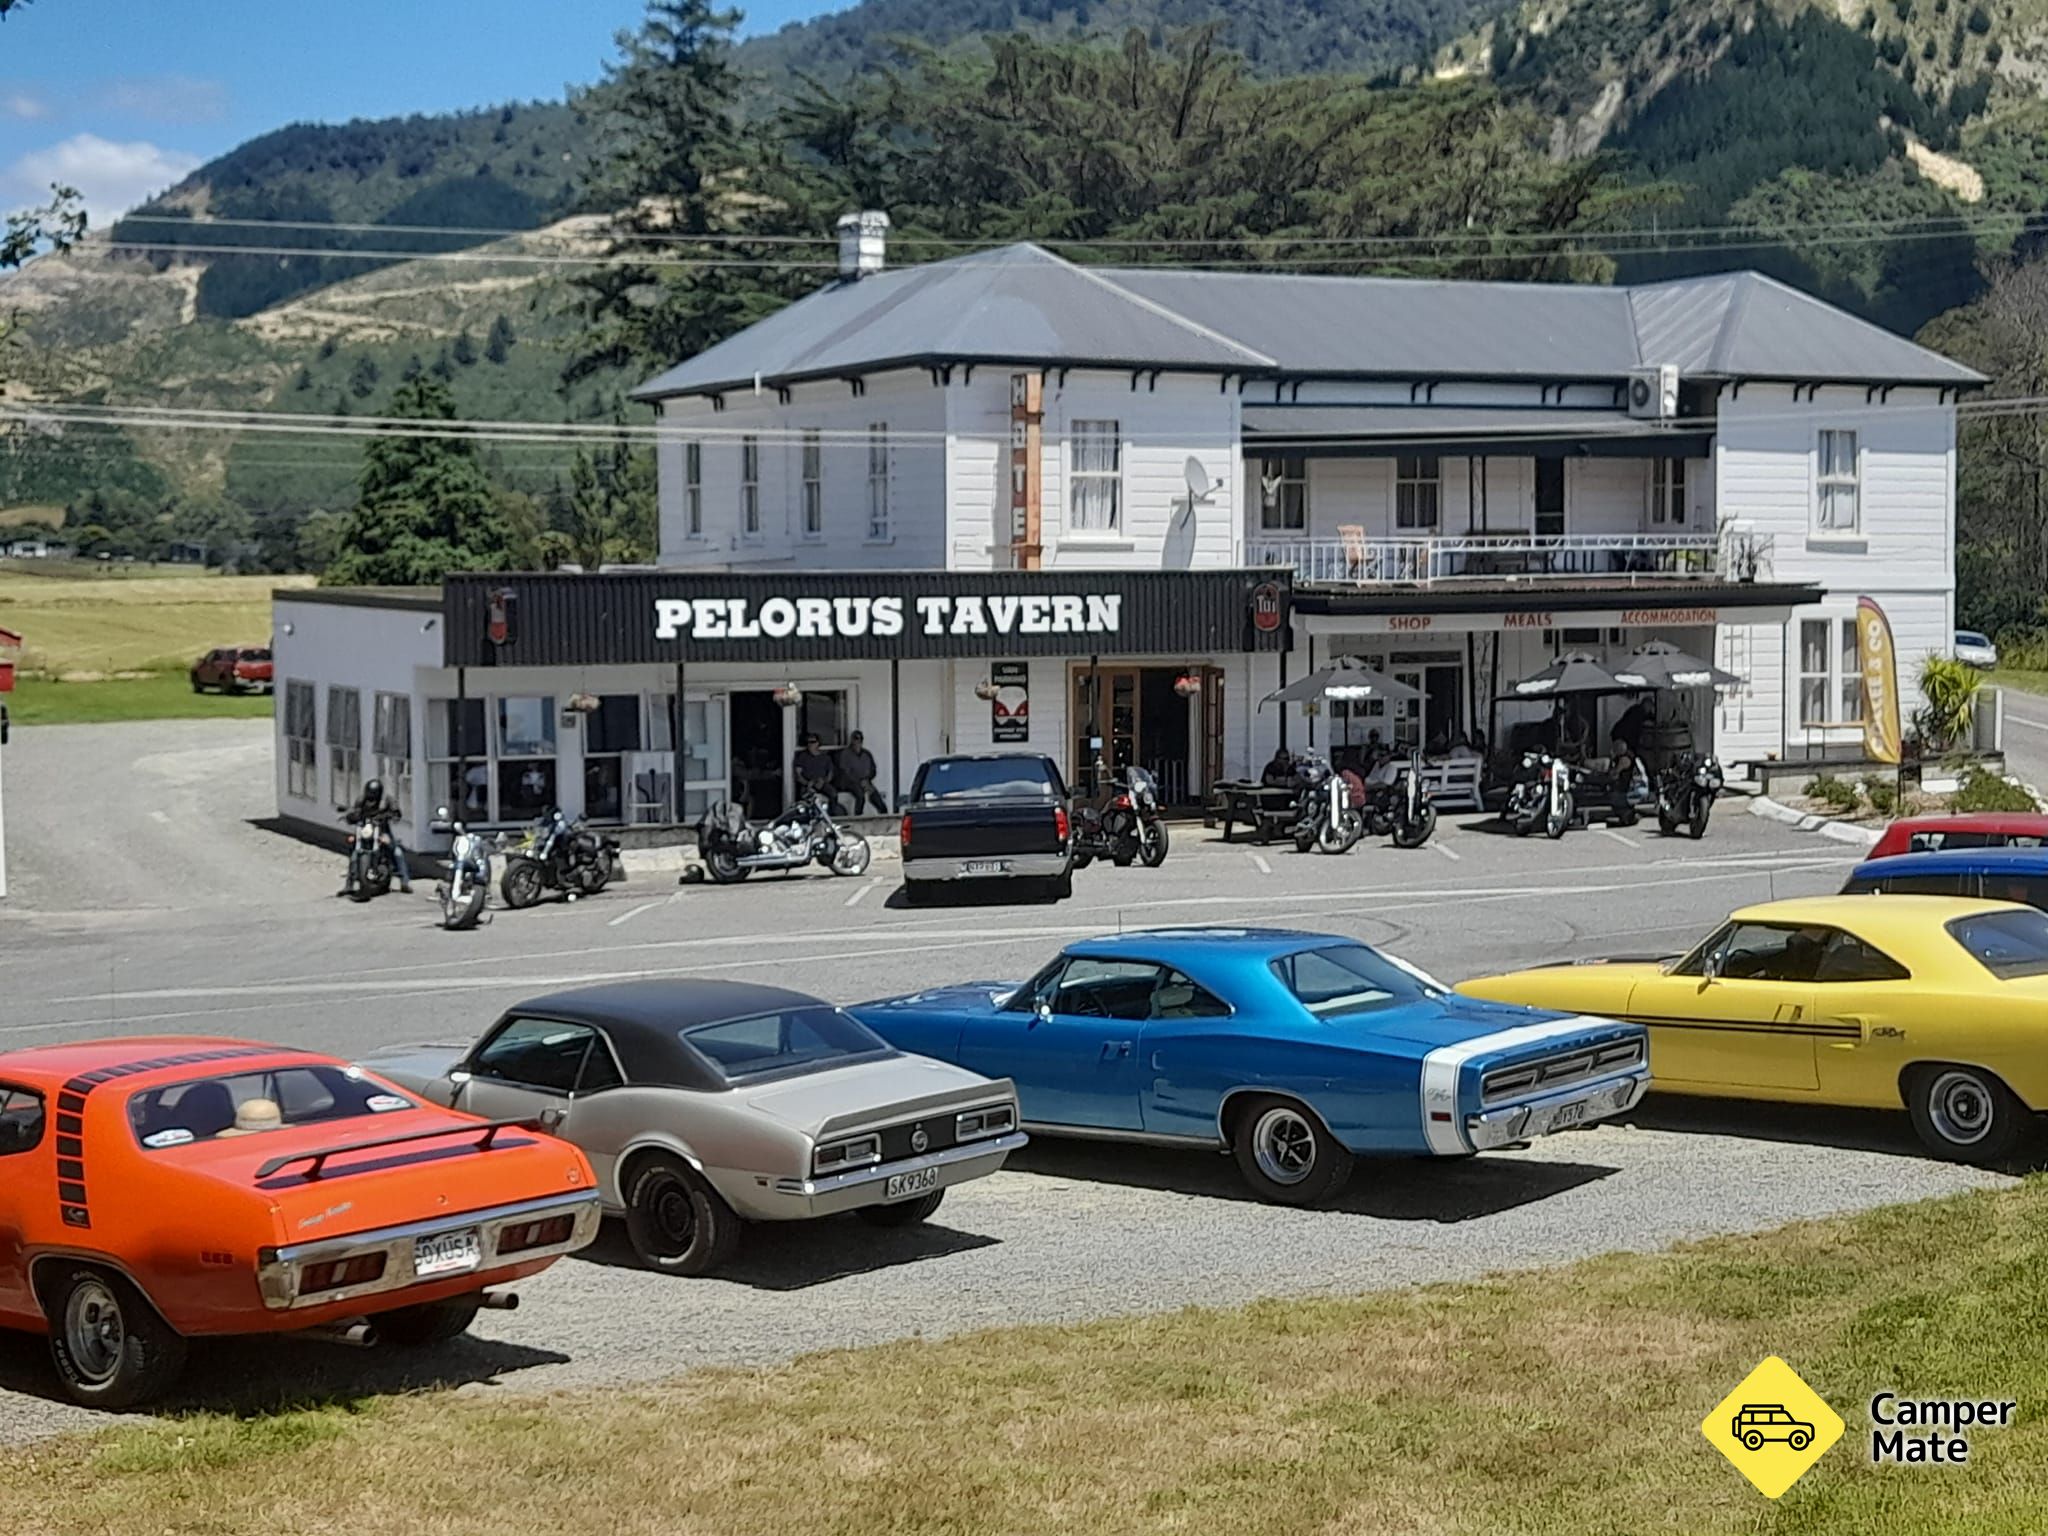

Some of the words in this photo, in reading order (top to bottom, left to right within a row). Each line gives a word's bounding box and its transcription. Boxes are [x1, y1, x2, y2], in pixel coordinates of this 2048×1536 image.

[655, 597, 903, 639] PELORUS
[917, 595, 1122, 635] TAVERN
[1388, 616, 1431, 630] SHOP
[1504, 613, 1553, 628] MEALS
[1620, 609, 1717, 624] ACCOMMODATION
[890, 1168, 936, 1195] SK9368
